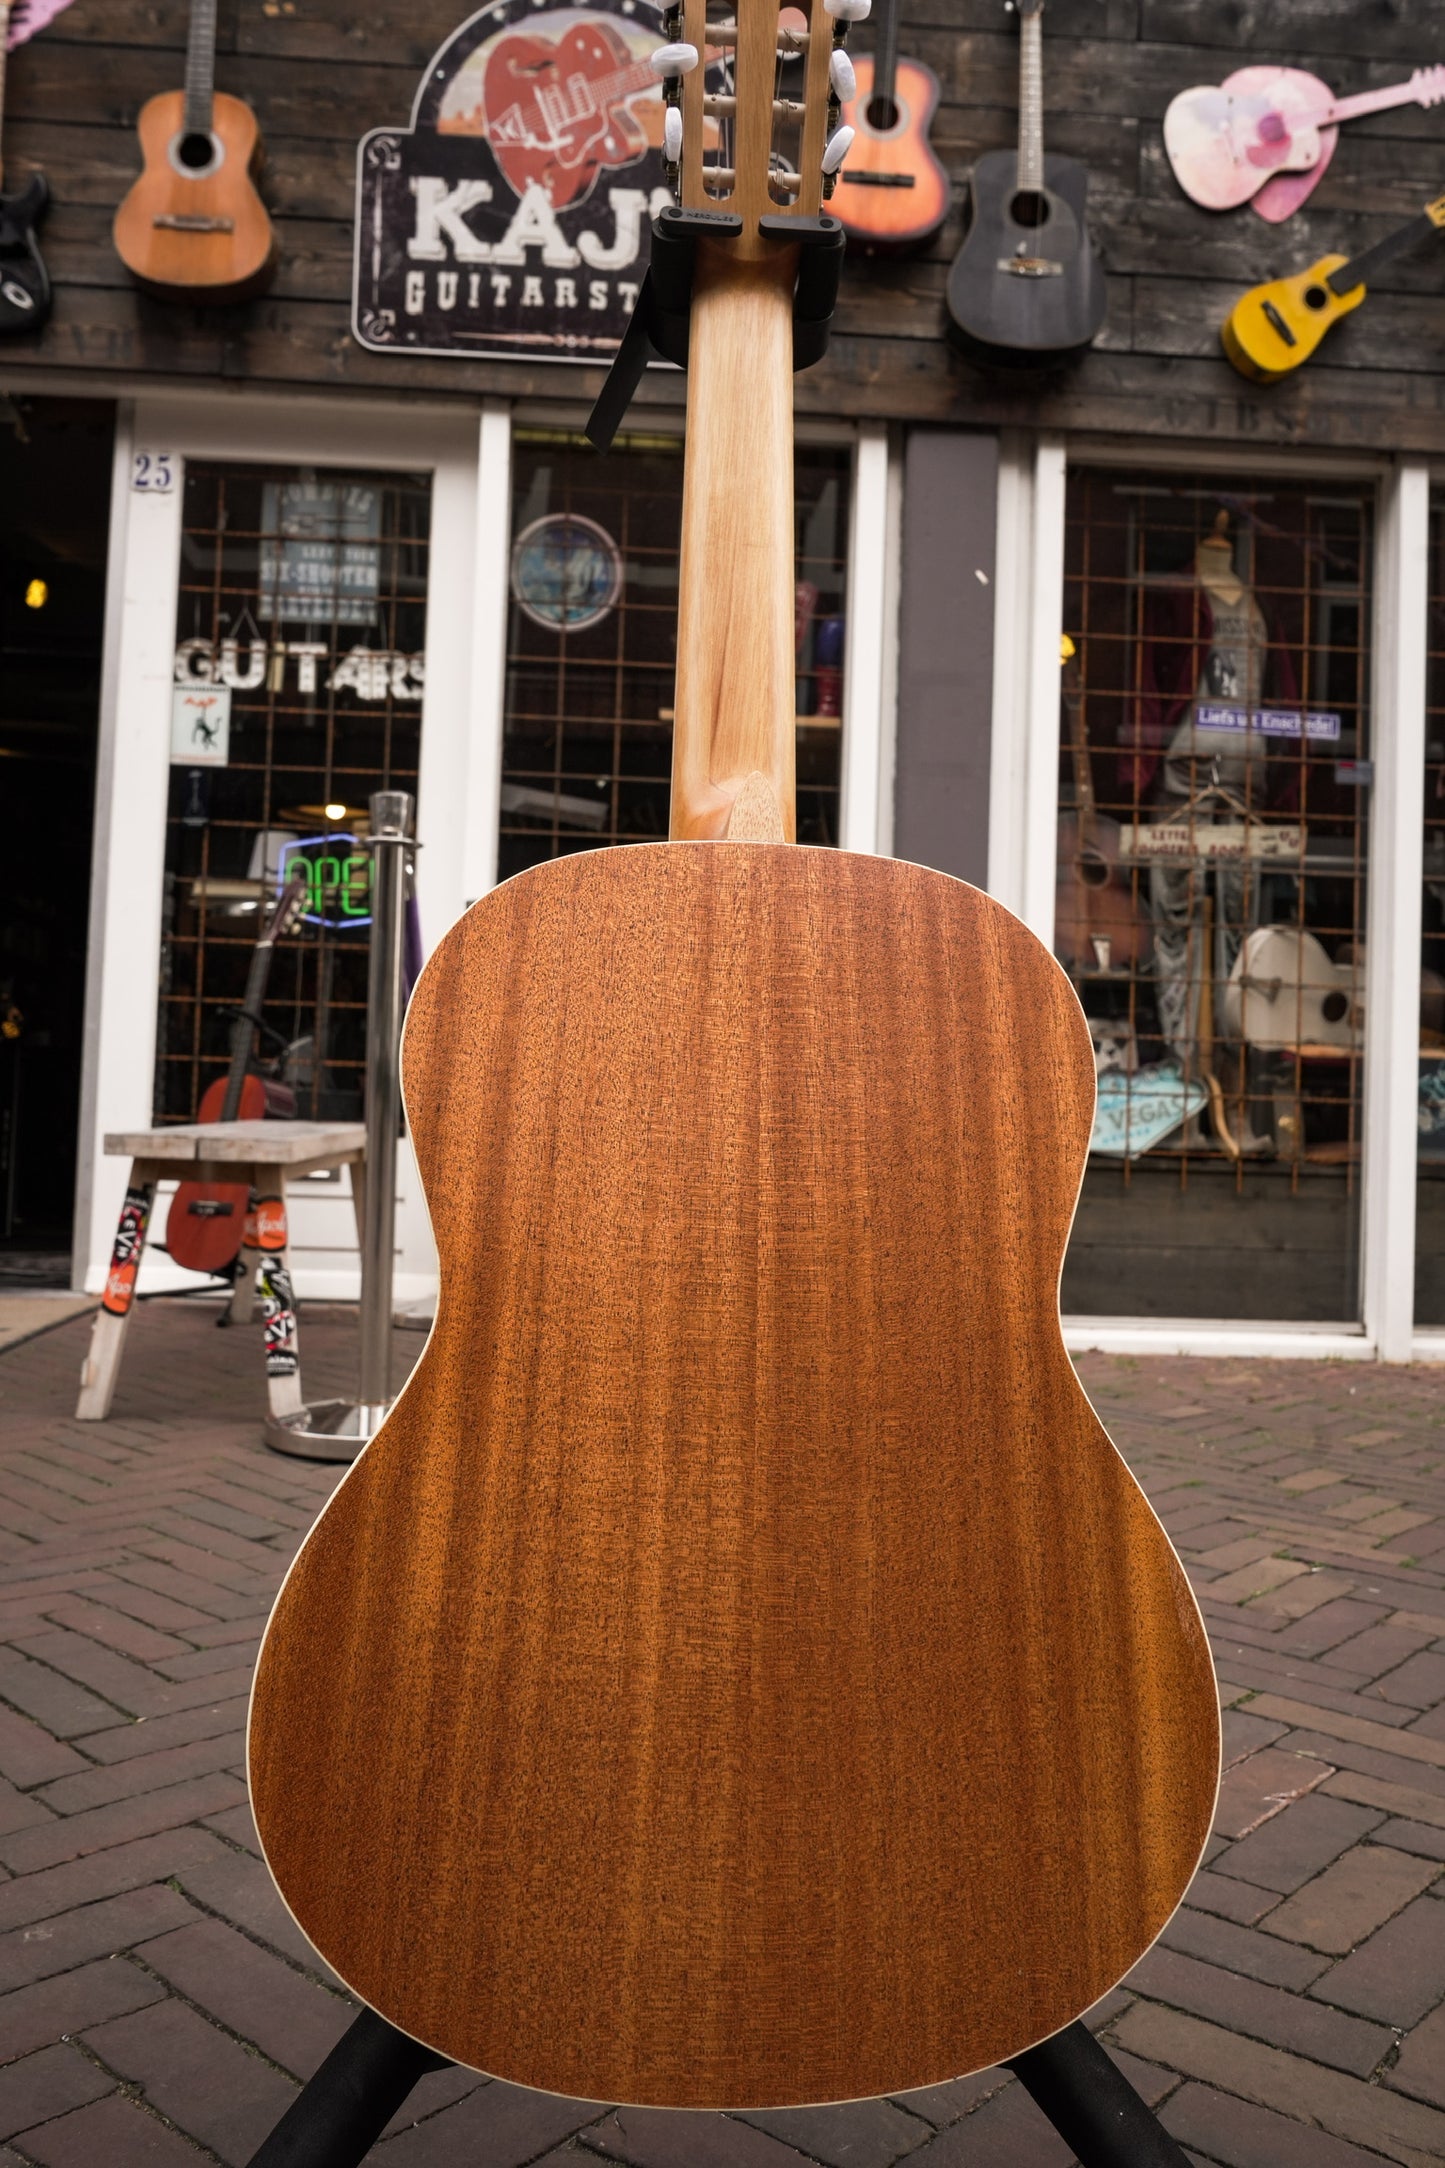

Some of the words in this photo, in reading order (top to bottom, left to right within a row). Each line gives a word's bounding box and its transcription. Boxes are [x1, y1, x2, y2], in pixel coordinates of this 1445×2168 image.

[407, 176, 676, 270] KAJ'
[404, 271, 638, 315] GUITARST
[134, 454, 171, 487] 25
[1237, 712, 1258, 728] ut
